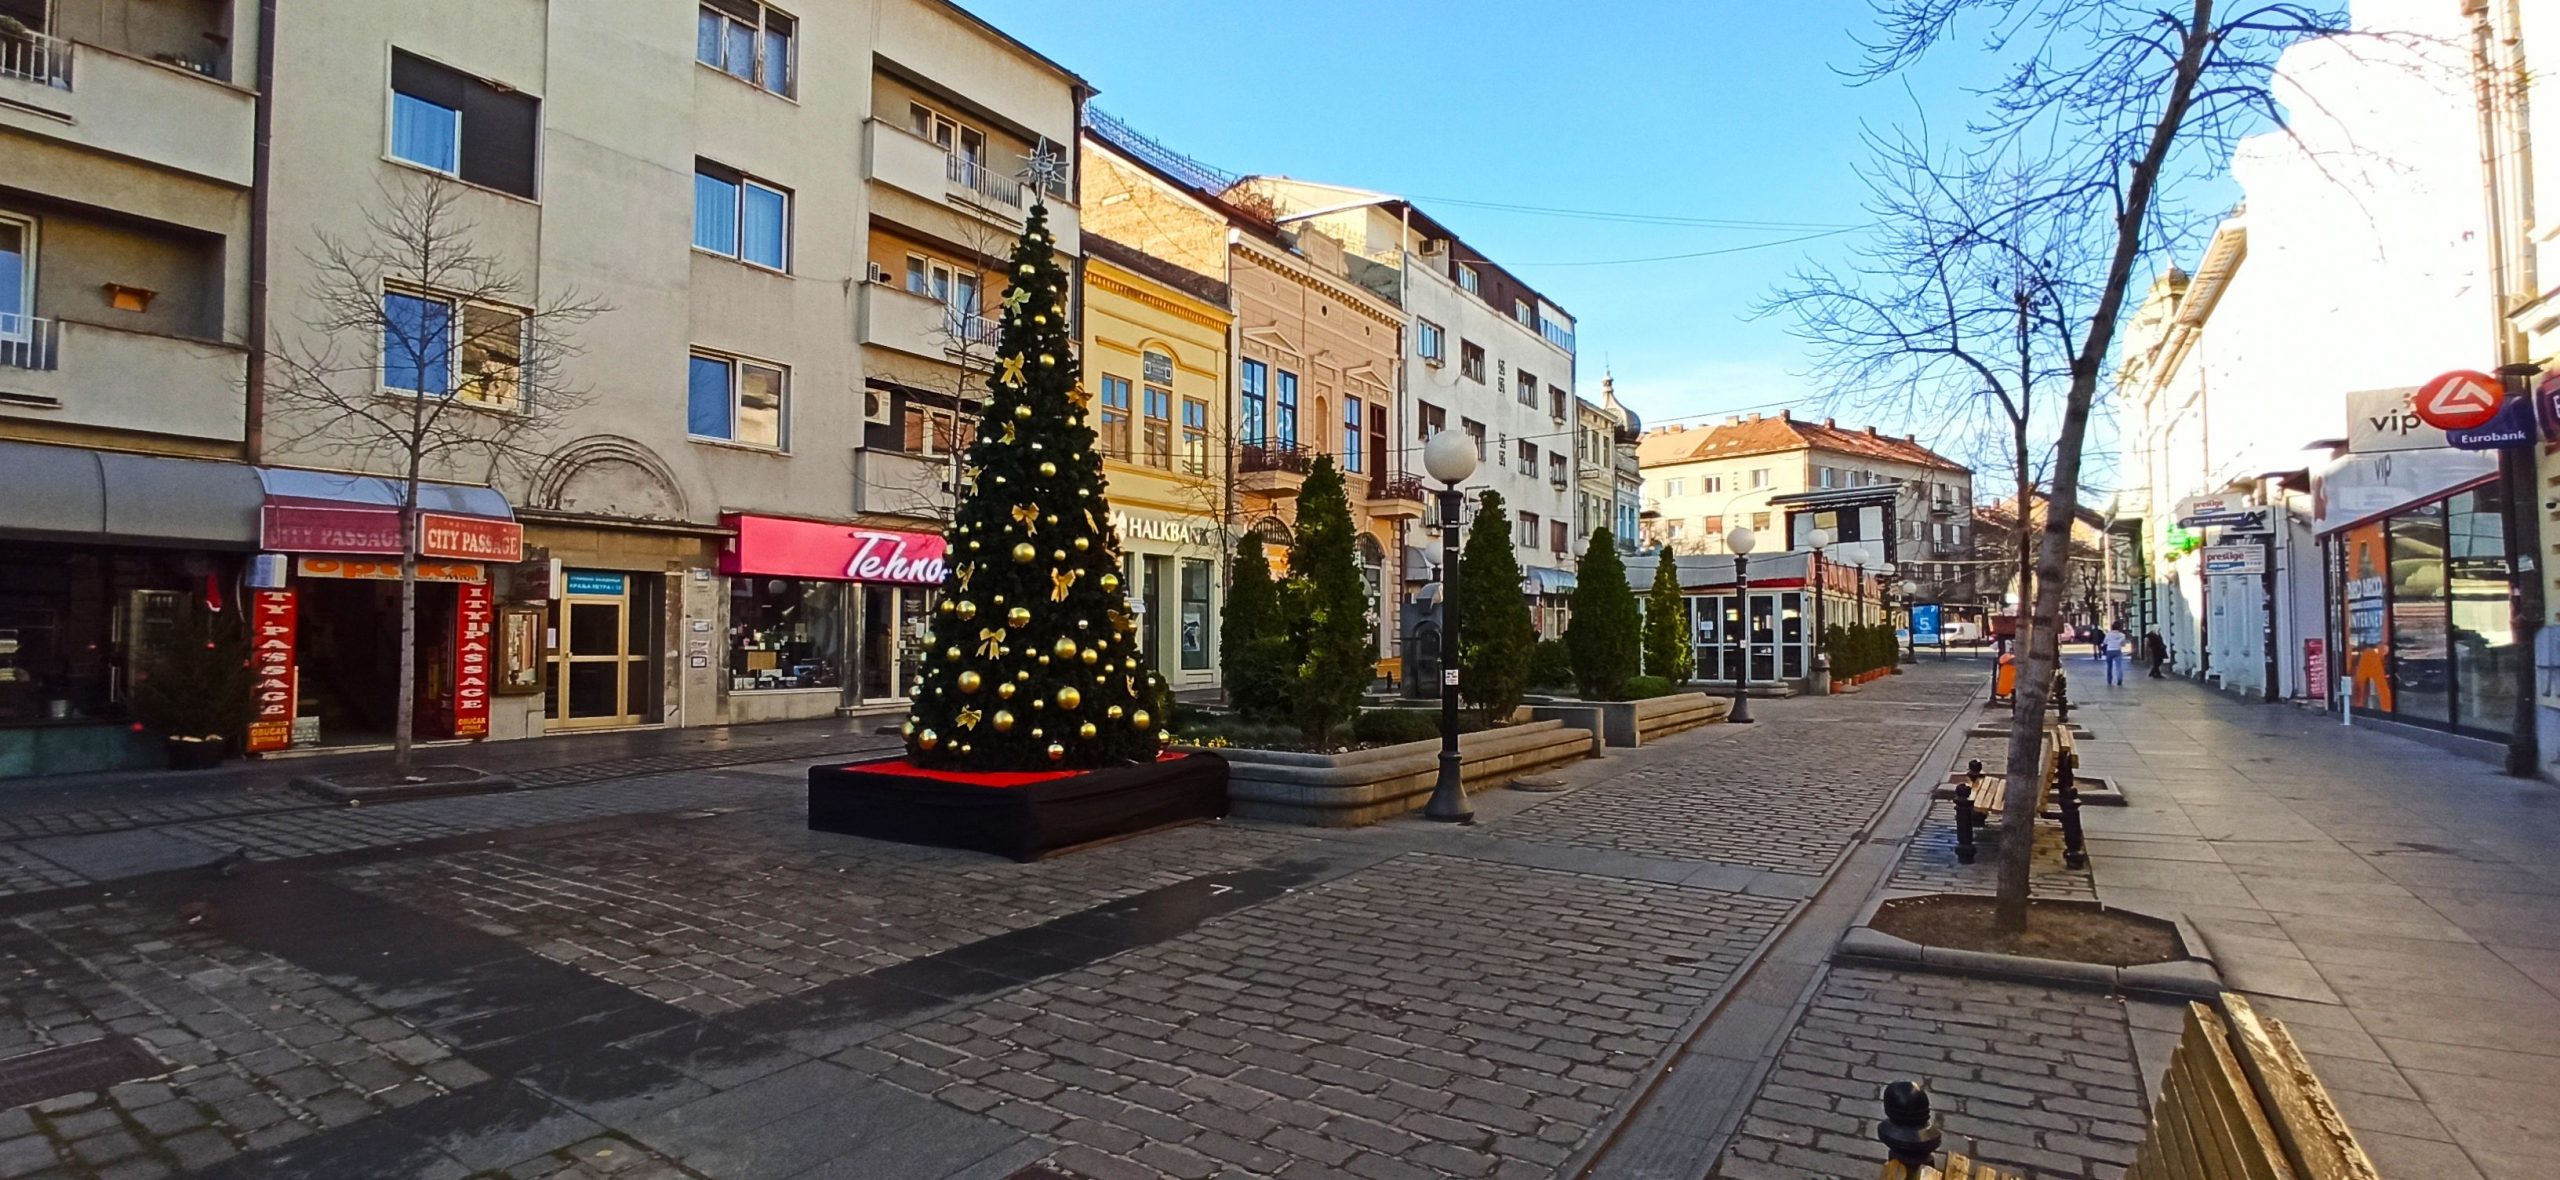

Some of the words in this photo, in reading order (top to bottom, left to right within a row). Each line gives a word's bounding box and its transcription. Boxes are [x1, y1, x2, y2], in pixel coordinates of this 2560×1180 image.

[2370, 409, 2421, 435] vip
[2461, 430, 2526, 445] Eurobank
[2374, 454, 2392, 485] vip
[2193, 500, 2224, 510] prestige
[428, 527, 460, 551] CITY
[462, 531, 518, 556] PASSAGE
[1129, 517, 1210, 546] HALKBANK
[303, 558, 479, 579] optka
[2207, 551, 2245, 562] prestige
[2349, 610, 2384, 628] INTERNET
[257, 623, 291, 715] PASSAGE
[459, 629, 487, 709] PASSAGE
